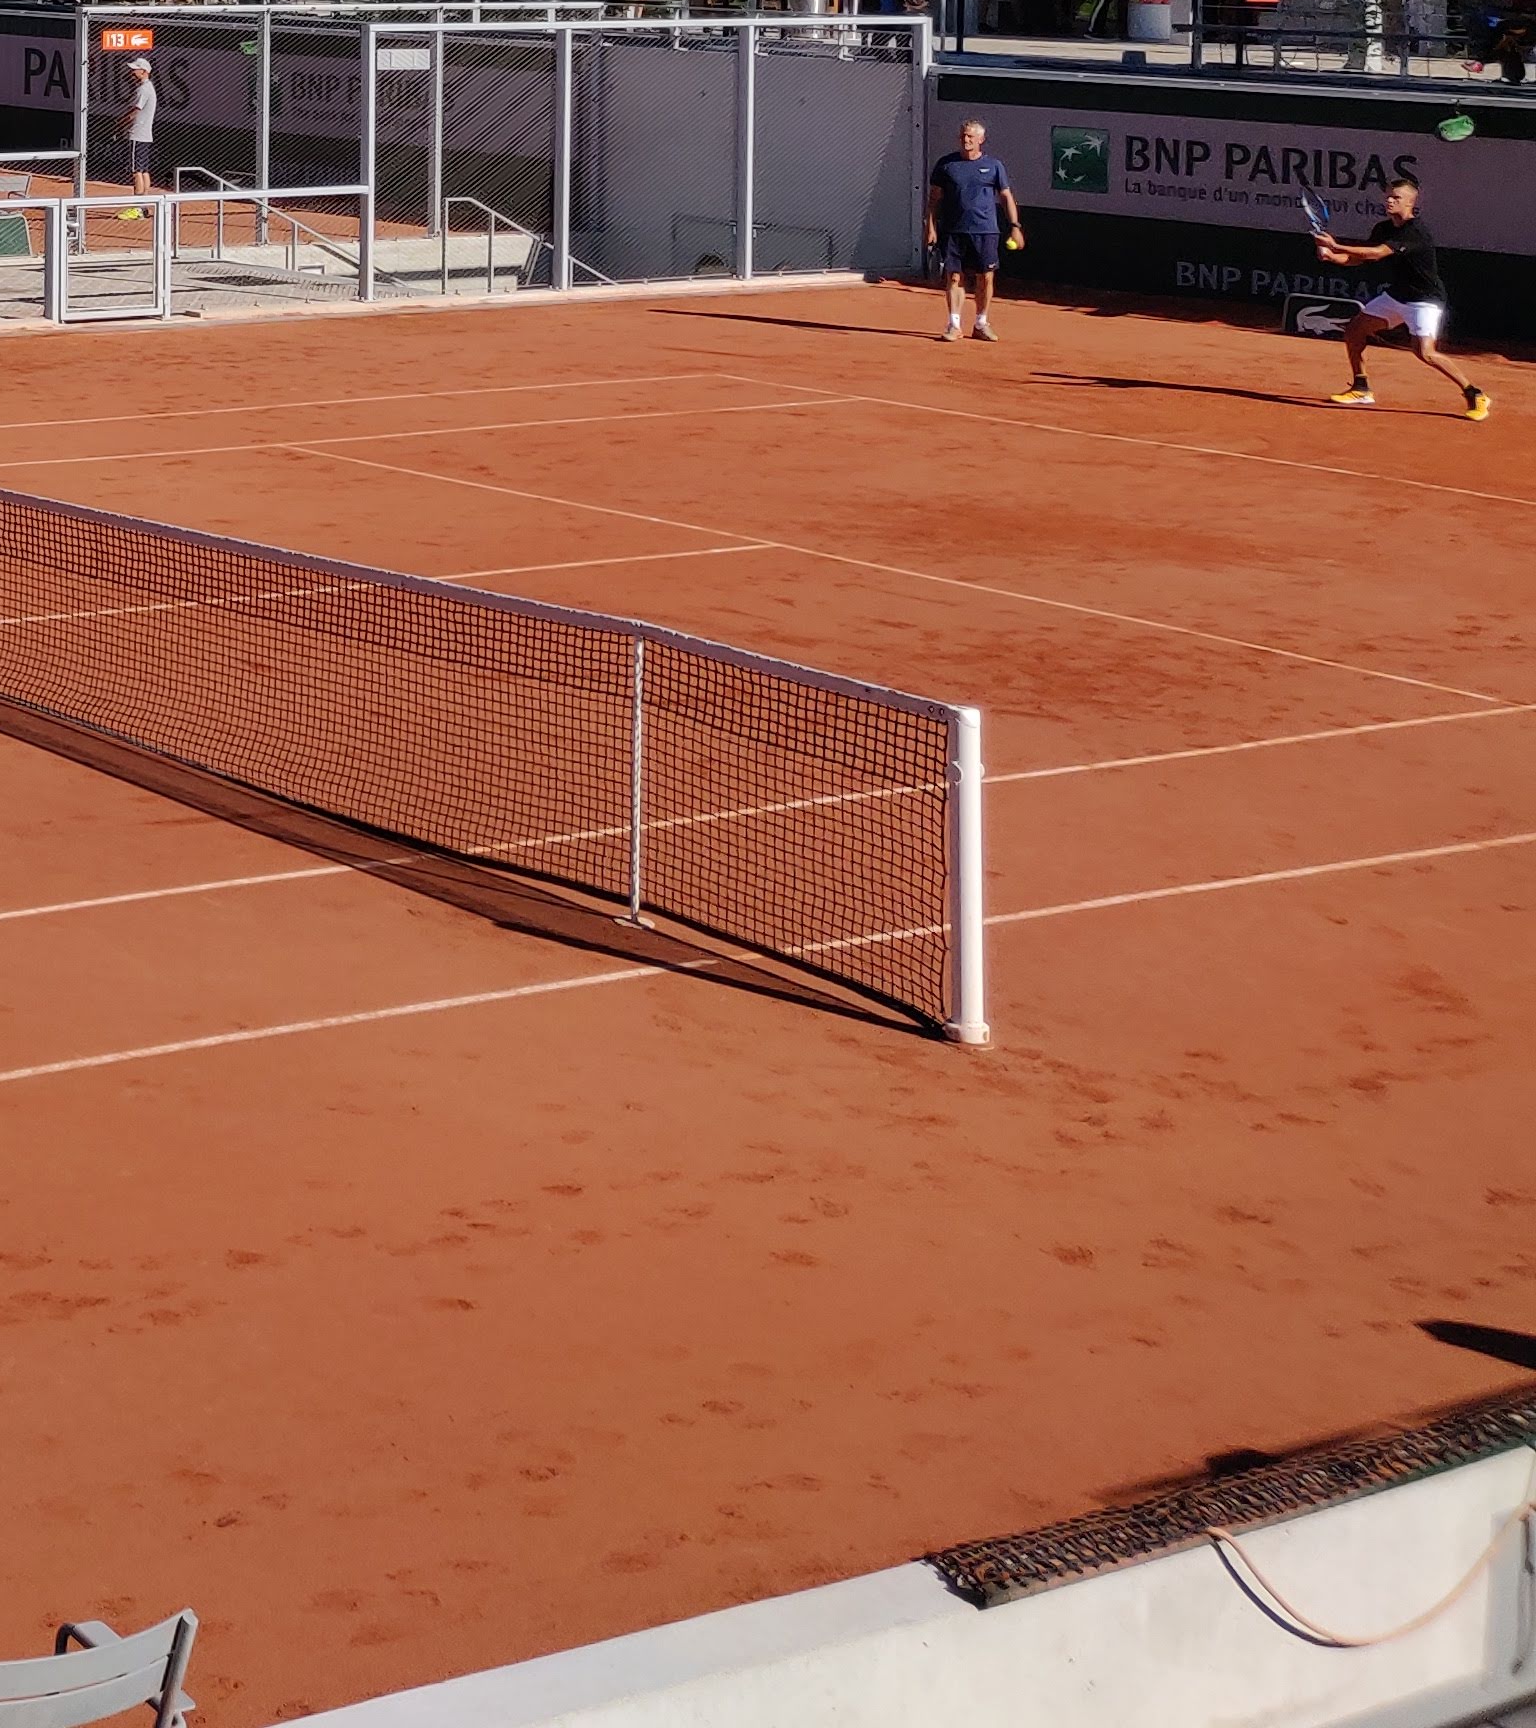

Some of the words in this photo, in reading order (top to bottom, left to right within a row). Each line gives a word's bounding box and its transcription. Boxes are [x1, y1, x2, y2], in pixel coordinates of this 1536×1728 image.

[110, 33, 125, 48] 13
[1125, 135, 1211, 177] BNP
[1225, 143, 1419, 192] PARIBAS
[1125, 177, 1141, 193] La
[1148, 179, 1207, 202] banque
[1213, 186, 1249, 204] d'un
[1176, 261, 1242, 291] BNP
